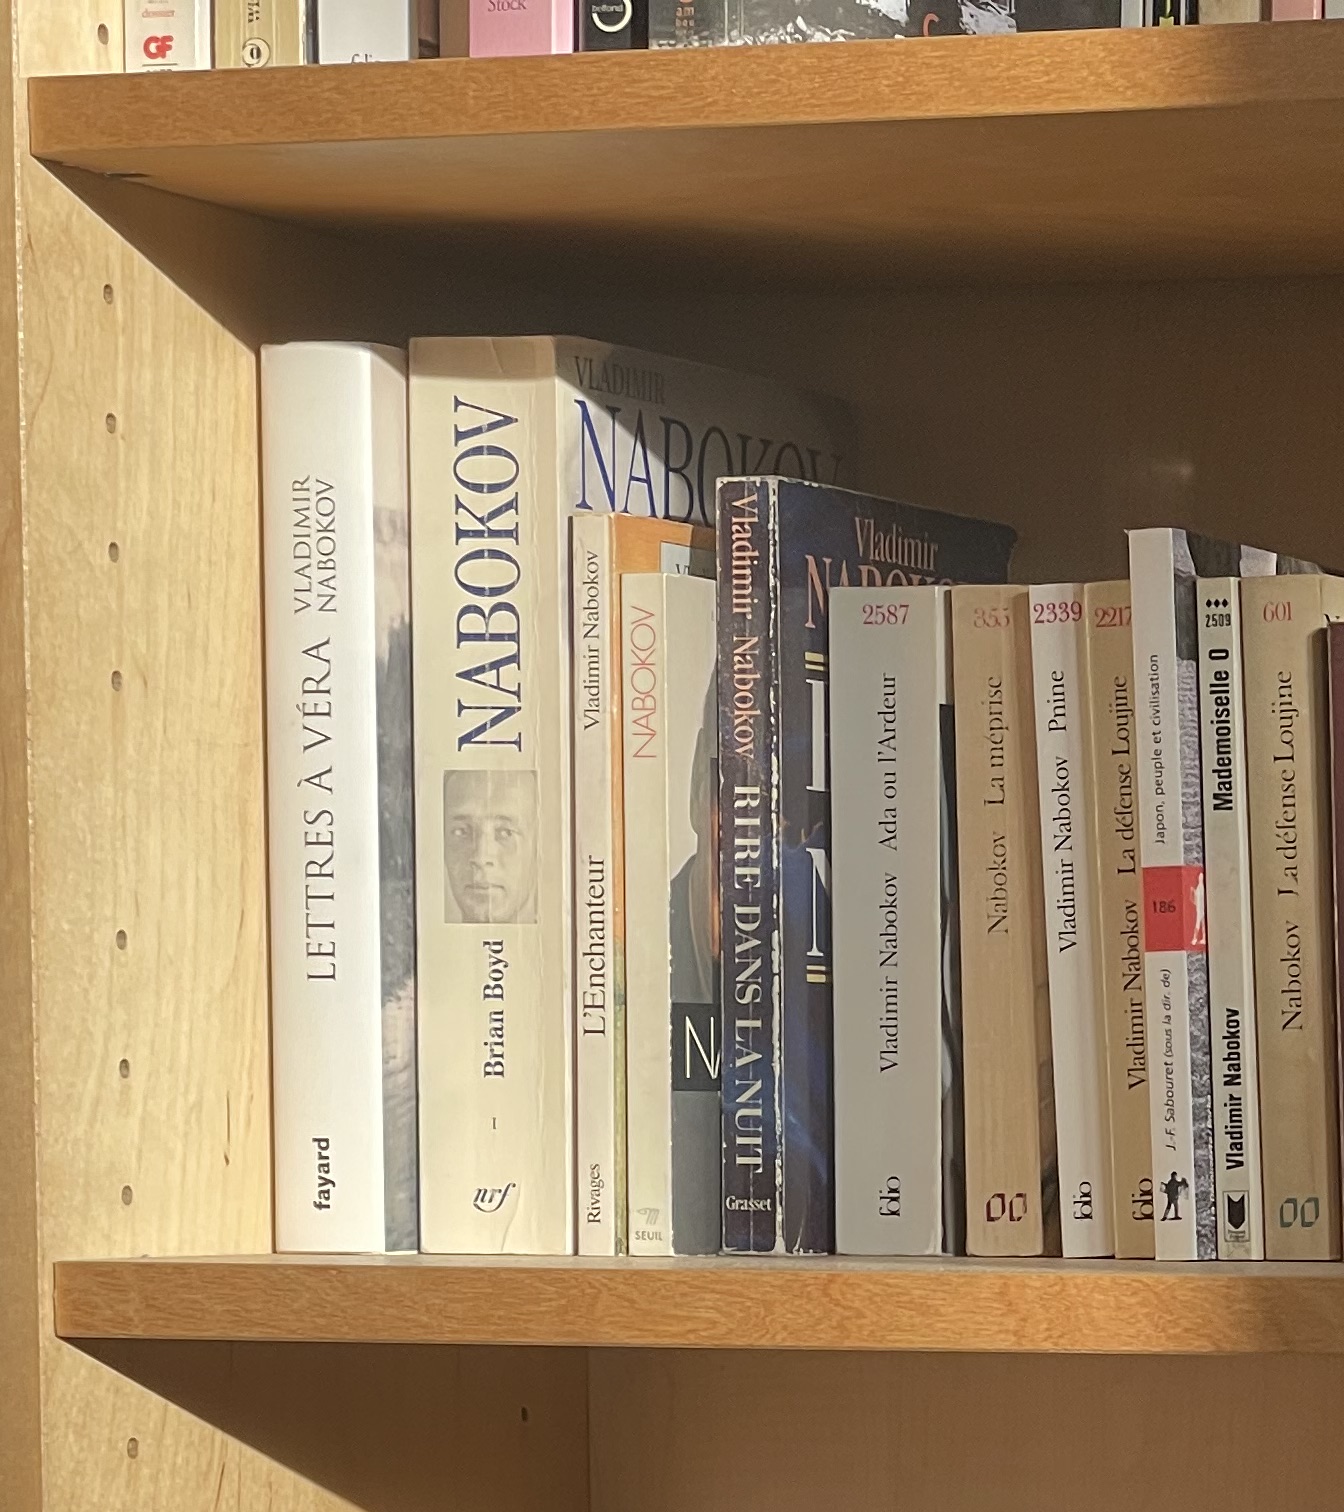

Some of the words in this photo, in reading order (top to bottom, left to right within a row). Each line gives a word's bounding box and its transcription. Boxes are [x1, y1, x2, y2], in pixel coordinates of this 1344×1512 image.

[294, 474, 312, 615] VLADIMIR
[316, 478, 337, 613] NABOKOV
[452, 395, 523, 754] NABOKOV
[731, 494, 758, 619] Vladimir
[584, 550, 601, 640] Nabokov
[1034, 602, 1083, 624] 2339
[1263, 604, 1292, 622] 601
[583, 645, 600, 731] Vladimir
[632, 607, 656, 759] NABOKOV
[734, 636, 761, 761] Nabokov
[1048, 671, 1067, 732] Pnine
[983, 677, 1010, 772] méprise
[985, 778, 1004, 806] La
[1052, 755, 1073, 852] Nabokov
[986, 831, 1009, 935] Nabokov
[1055, 859, 1076, 954] Vladimir
[1152, 901, 1176, 913] 186
[483, 940, 510, 1000] Boyd
[484, 1009, 506, 1079] Brian
[1222, 1007, 1241, 1087] Nabokov
[1225, 1094, 1245, 1170] Vladimir
[313, 1136, 336, 1211] fayard
[586, 1163, 603, 1224] Rivages
[1074, 1181, 1093, 1220] folio
[1133, 1177, 1154, 1221] folio
